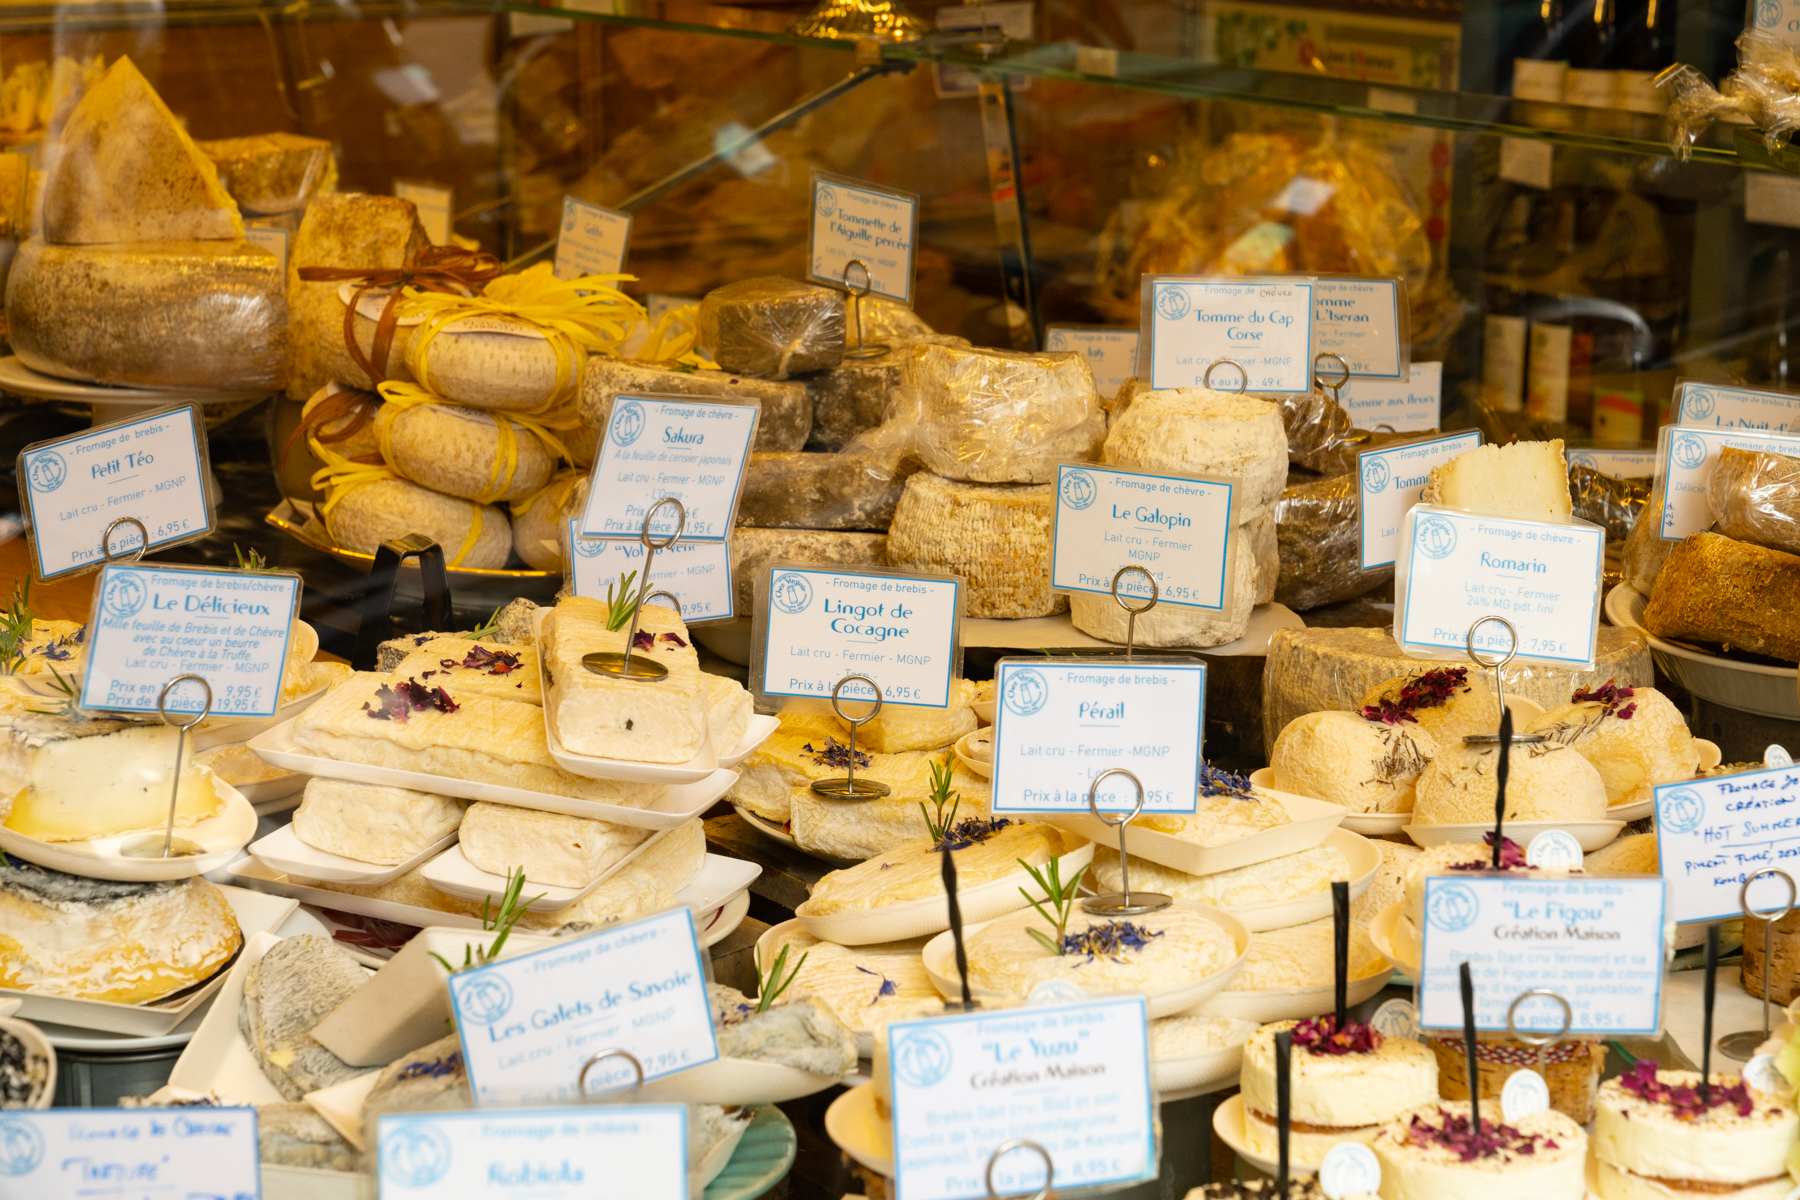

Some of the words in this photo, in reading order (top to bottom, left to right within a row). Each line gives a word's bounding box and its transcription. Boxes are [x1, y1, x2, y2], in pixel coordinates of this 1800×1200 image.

[837, 208, 886, 230] Tommette
[889, 221, 901, 234] de
[876, 237, 909, 250] percée
[1205, 286, 1242, 296] Fromage
[1193, 310, 1244, 323] Tomme
[1248, 311, 1264, 323] du
[1270, 311, 1294, 328] Cap
[1227, 327, 1263, 340] Corse
[1334, 330, 1365, 338] Fermier
[1177, 356, 1193, 365] Lait
[1196, 357, 1210, 365] cru
[1262, 378, 1273, 386] 49
[1348, 398, 1385, 408] Tomme
[1387, 397, 1404, 406] aux
[1408, 394, 1434, 404] fleurs
[1718, 393, 1749, 402] Fromage
[661, 405, 694, 419] Fromage
[696, 408, 706, 418] de
[708, 410, 733, 420] chèvre
[1716, 415, 1733, 428] La
[76, 438, 117, 455] Fromage
[120, 433, 130, 442] de
[135, 425, 163, 438] brebis
[663, 426, 704, 444] Sakura
[623, 450, 630, 459] la
[631, 450, 656, 461] feuille
[658, 451, 667, 462] de
[669, 452, 698, 463] cerisier
[698, 454, 732, 466] japonais
[1401, 448, 1429, 460] Fromage
[1442, 442, 1462, 451] brebis
[92, 459, 120, 479] Petit
[124, 451, 154, 468] Téo
[618, 473, 634, 482] Lait
[635, 474, 649, 482] cru
[657, 473, 690, 484] Fermier
[698, 476, 725, 486] MGNP
[1116, 478, 1155, 492] Fromage
[1160, 483, 1170, 492] de
[1174, 485, 1204, 496] chèvre
[60, 509, 79, 521] Lait
[82, 504, 97, 514] cru
[107, 489, 145, 506] Fermier
[156, 476, 186, 493] MGNP
[1113, 504, 1130, 519] Le
[1136, 506, 1191, 530] Galopin
[72, 551, 94, 562] Prix
[158, 521, 180, 537] 6,95
[1105, 531, 1123, 542] Lait
[1125, 535, 1142, 545] cru
[1153, 537, 1192, 550] Fermier
[1478, 524, 1522, 540] Fromage
[1526, 530, 1537, 540] de
[1541, 532, 1573, 543] chèvre
[1129, 550, 1160, 561] MGNP
[1480, 552, 1546, 574] Romarin
[687, 565, 715, 575] MGNP
[151, 575, 197, 589] Fromage
[200, 577, 212, 589] de
[216, 579, 284, 592] brebis/chèvre
[833, 578, 877, 592] Fromage
[881, 581, 892, 591] de
[896, 582, 926, 594] brebis
[1166, 586, 1189, 598] 6,95
[1465, 582, 1485, 593] Lait
[1488, 585, 1505, 595] cru
[1517, 587, 1560, 601] Fermier
[153, 593, 178, 610] Le
[185, 595, 270, 615] Délicieux
[682, 604, 702, 614] 9,95
[825, 598, 884, 621] Lingot
[891, 603, 913, 619] de
[1467, 595, 1489, 607] 24%
[1493, 599, 1510, 609] MG
[1513, 600, 1533, 613] pdt.
[1537, 603, 1553, 614] fini
[102, 618, 129, 629] Mille
[132, 620, 165, 632] feuille
[168, 622, 181, 632] de
[184, 623, 218, 634] Brebis
[221, 625, 231, 635] et
[234, 626, 247, 636] de
[249, 626, 284, 637] Chèvre
[831, 618, 909, 641] Cocagne
[133, 634, 158, 643] avec
[176, 636, 205, 646] coeur
[209, 638, 222, 646] un
[225, 637, 260, 649] beurre
[1531, 638, 1556, 651] 7,95
[143, 646, 156, 656] de
[159, 646, 196, 658] Chèvre
[200, 648, 205, 658] à
[208, 649, 218, 658] la
[221, 649, 253, 661] Truffe.
[790, 646, 810, 657] Lait
[814, 649, 830, 658] cru
[843, 650, 885, 662] Fermier
[897, 654, 930, 666] MGNP
[126, 657, 147, 668] Lait
[150, 660, 168, 669] cru
[180, 660, 223, 672] Fermier
[235, 662, 269, 673] MGNP
[1068, 673, 1115, 686] Fromage
[1119, 674, 1131, 684] de
[1135, 674, 1168, 685] brebis
[110, 680, 136, 693] Prix
[140, 683, 155, 694] en
[227, 686, 251, 698] 9,95
[885, 686, 910, 699] 6,95
[107, 693, 132, 705] Prix
[136, 695, 151, 706] de
[171, 698, 204, 710] pièce
[218, 699, 248, 712] 19,95
[1079, 701, 1124, 719] Pérail
[1021, 745, 1042, 756] Lait
[1046, 746, 1064, 756] cru
[1078, 746, 1124, 756] Fermier
[1494, 925, 1558, 940] Création
[1563, 926, 1621, 941] Maison
[489, 1020, 526, 1043] Les
[531, 1000, 592, 1030] Galets
[599, 989, 622, 1011] de
[629, 971, 692, 1002] Savoie
[971, 1070, 1040, 1090] Création
[1047, 1062, 1106, 1080] Maison
